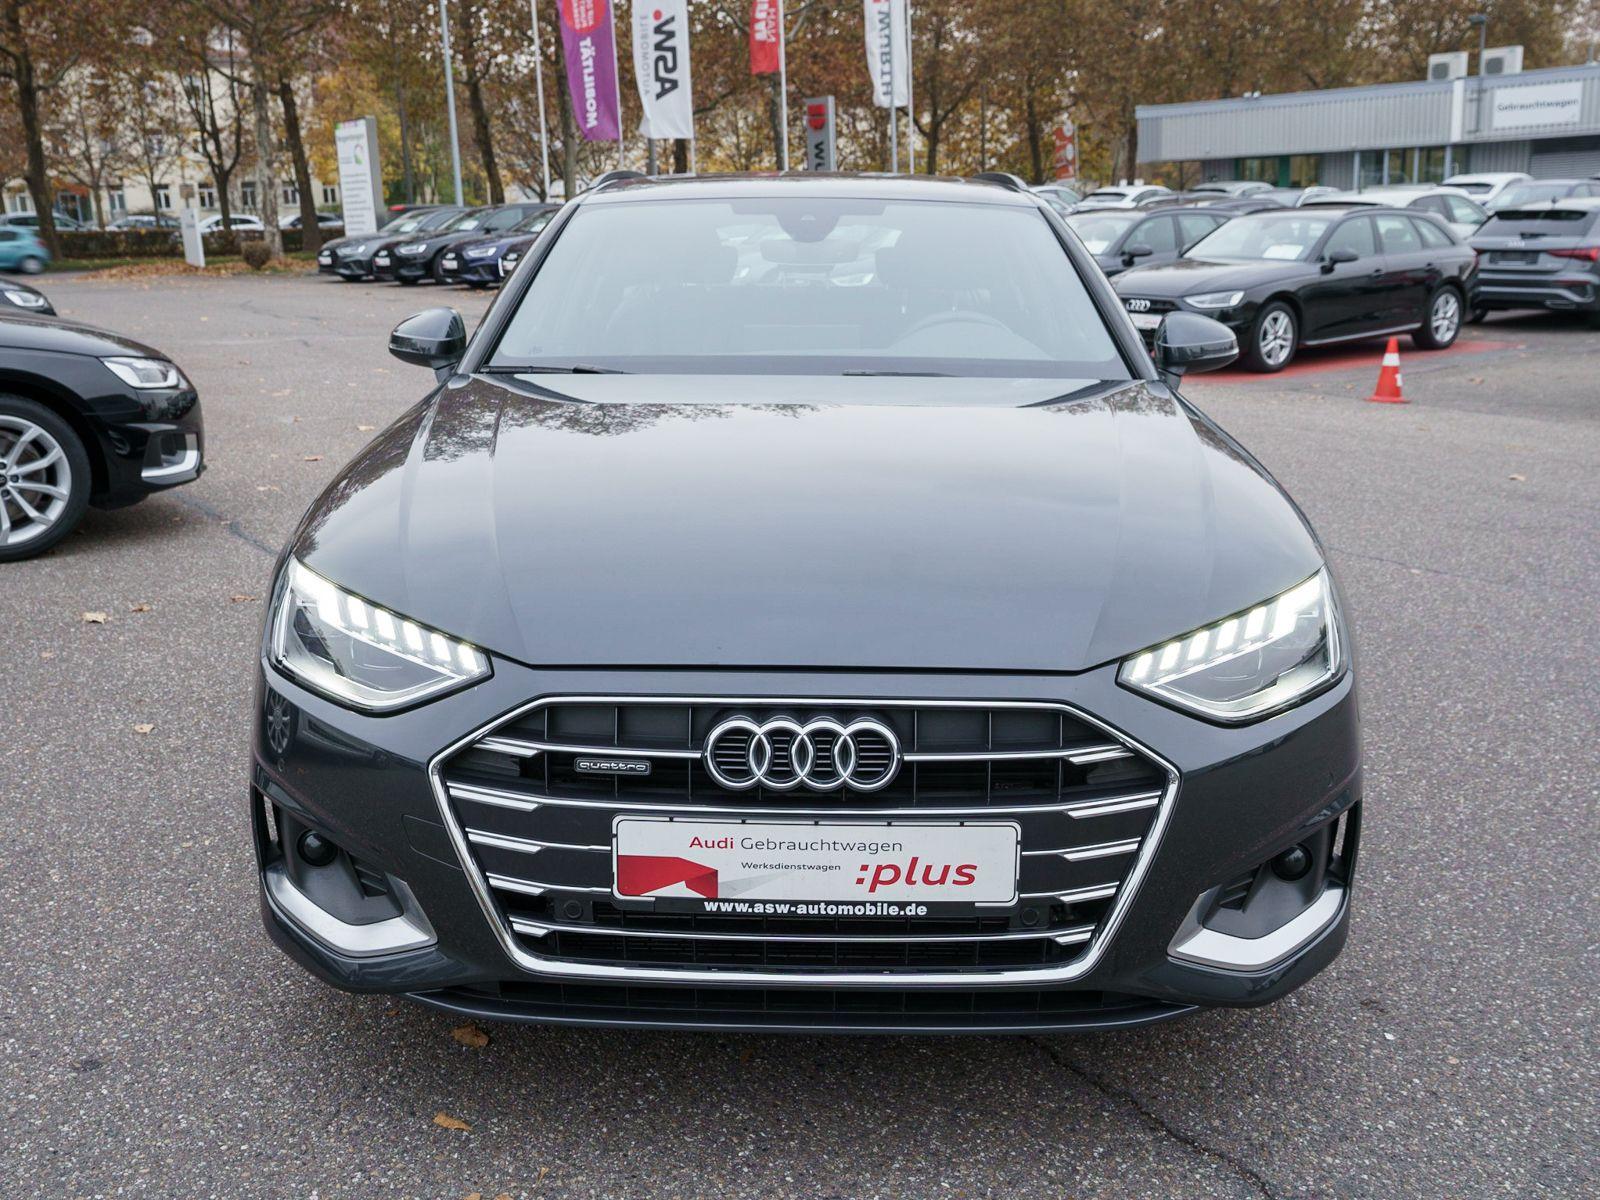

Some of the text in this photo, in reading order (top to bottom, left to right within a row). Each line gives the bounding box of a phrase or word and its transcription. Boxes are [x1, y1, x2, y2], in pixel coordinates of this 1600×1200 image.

[1497, 99, 1579, 111] Gebrauchtwagen
[579, 762, 646, 771] quattro
[689, 836, 903, 855] Audi Gebrauchtwagen
[741, 861, 841, 872] Werksdienstwagen
[855, 856, 978, 893] :plus
[703, 900, 928, 916] www.asw-automobile.de
